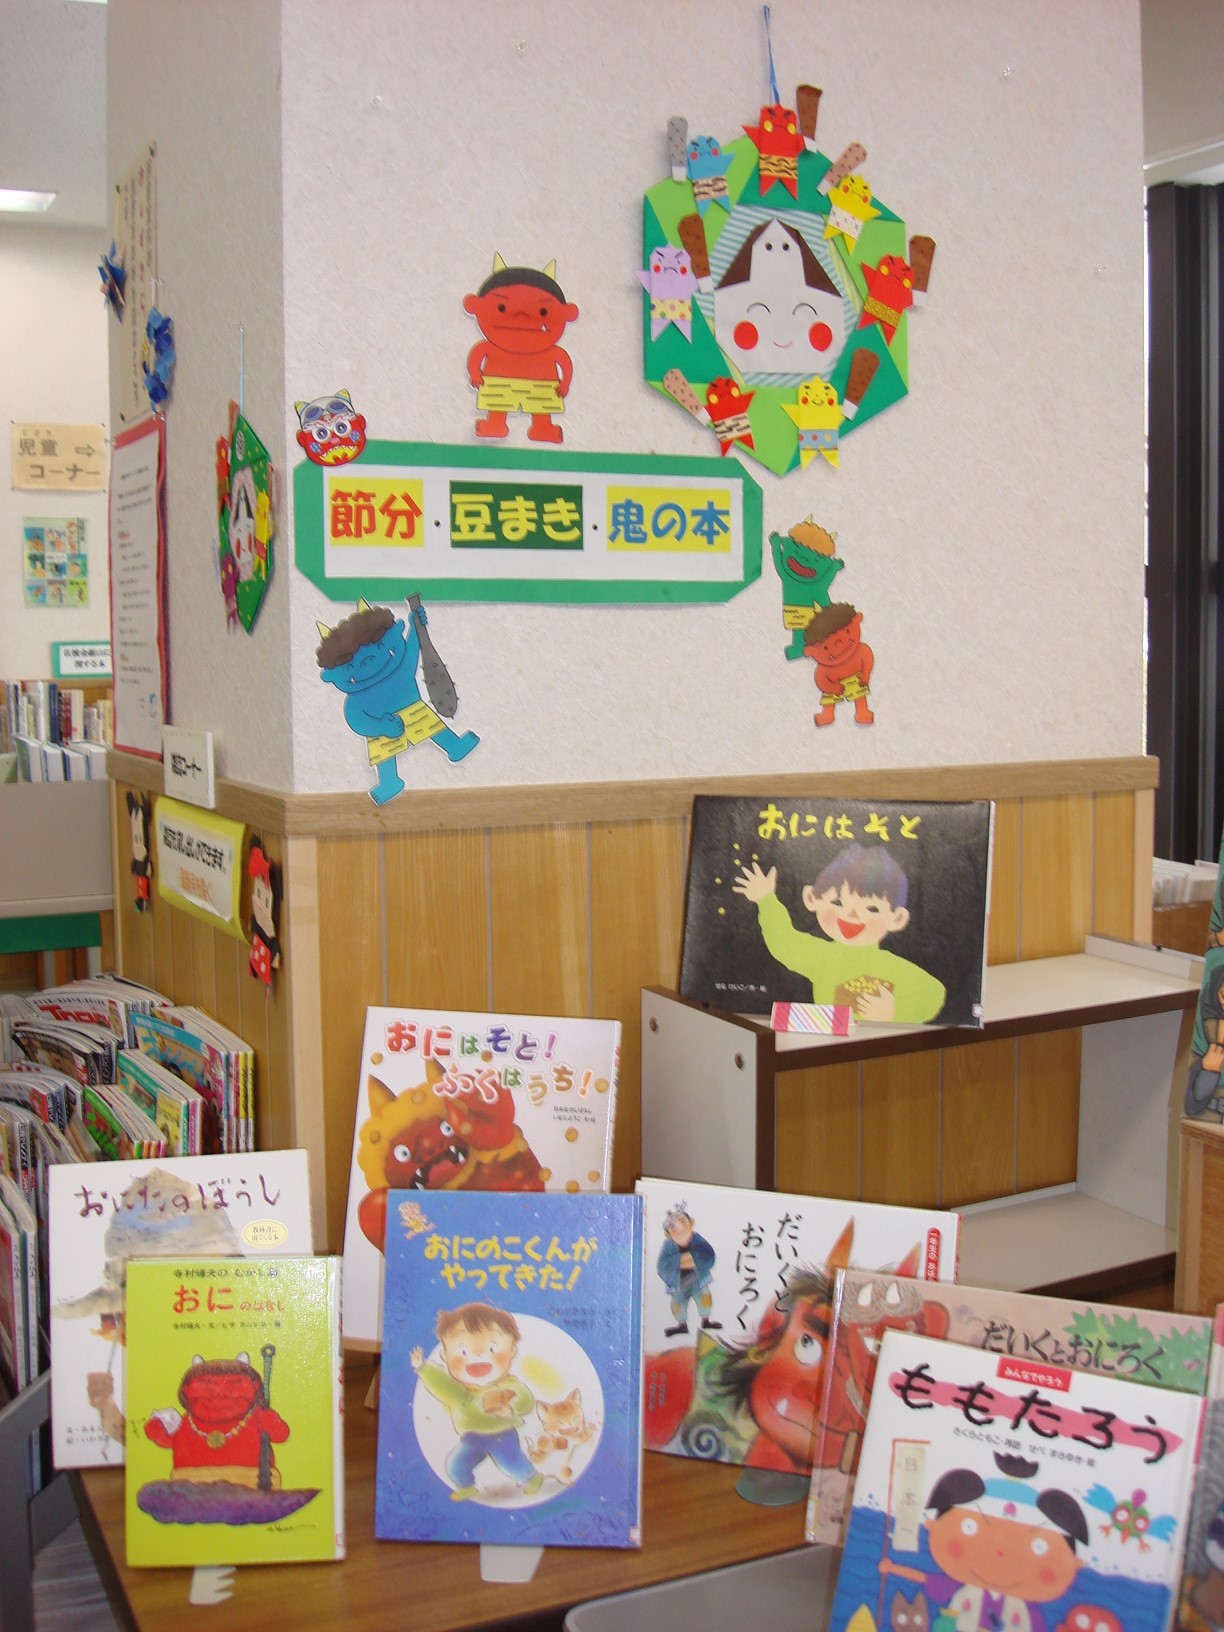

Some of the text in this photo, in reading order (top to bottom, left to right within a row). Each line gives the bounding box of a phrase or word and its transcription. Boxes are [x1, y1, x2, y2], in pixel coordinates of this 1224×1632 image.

[18, 438, 59, 457] 児童
[29, 464, 101, 481] コーナー
[757, 803, 922, 841] おにはそと
[385, 1019, 558, 1061] おにはそと！
[433, 1062, 594, 1105] ふくはうち！
[74, 1173, 281, 1218] おにたのぼうし
[424, 1233, 599, 1264] おにのこくんが
[774, 1211, 803, 1314] だいくと
[440, 1262, 582, 1291] やってきた！
[736, 1222, 766, 1331] おにろく
[981, 1320, 1166, 1380] だいくとおにろく
[1004, 1366, 1063, 1388] みんなでやろう
[894, 1363, 1169, 1464] ももたろう
